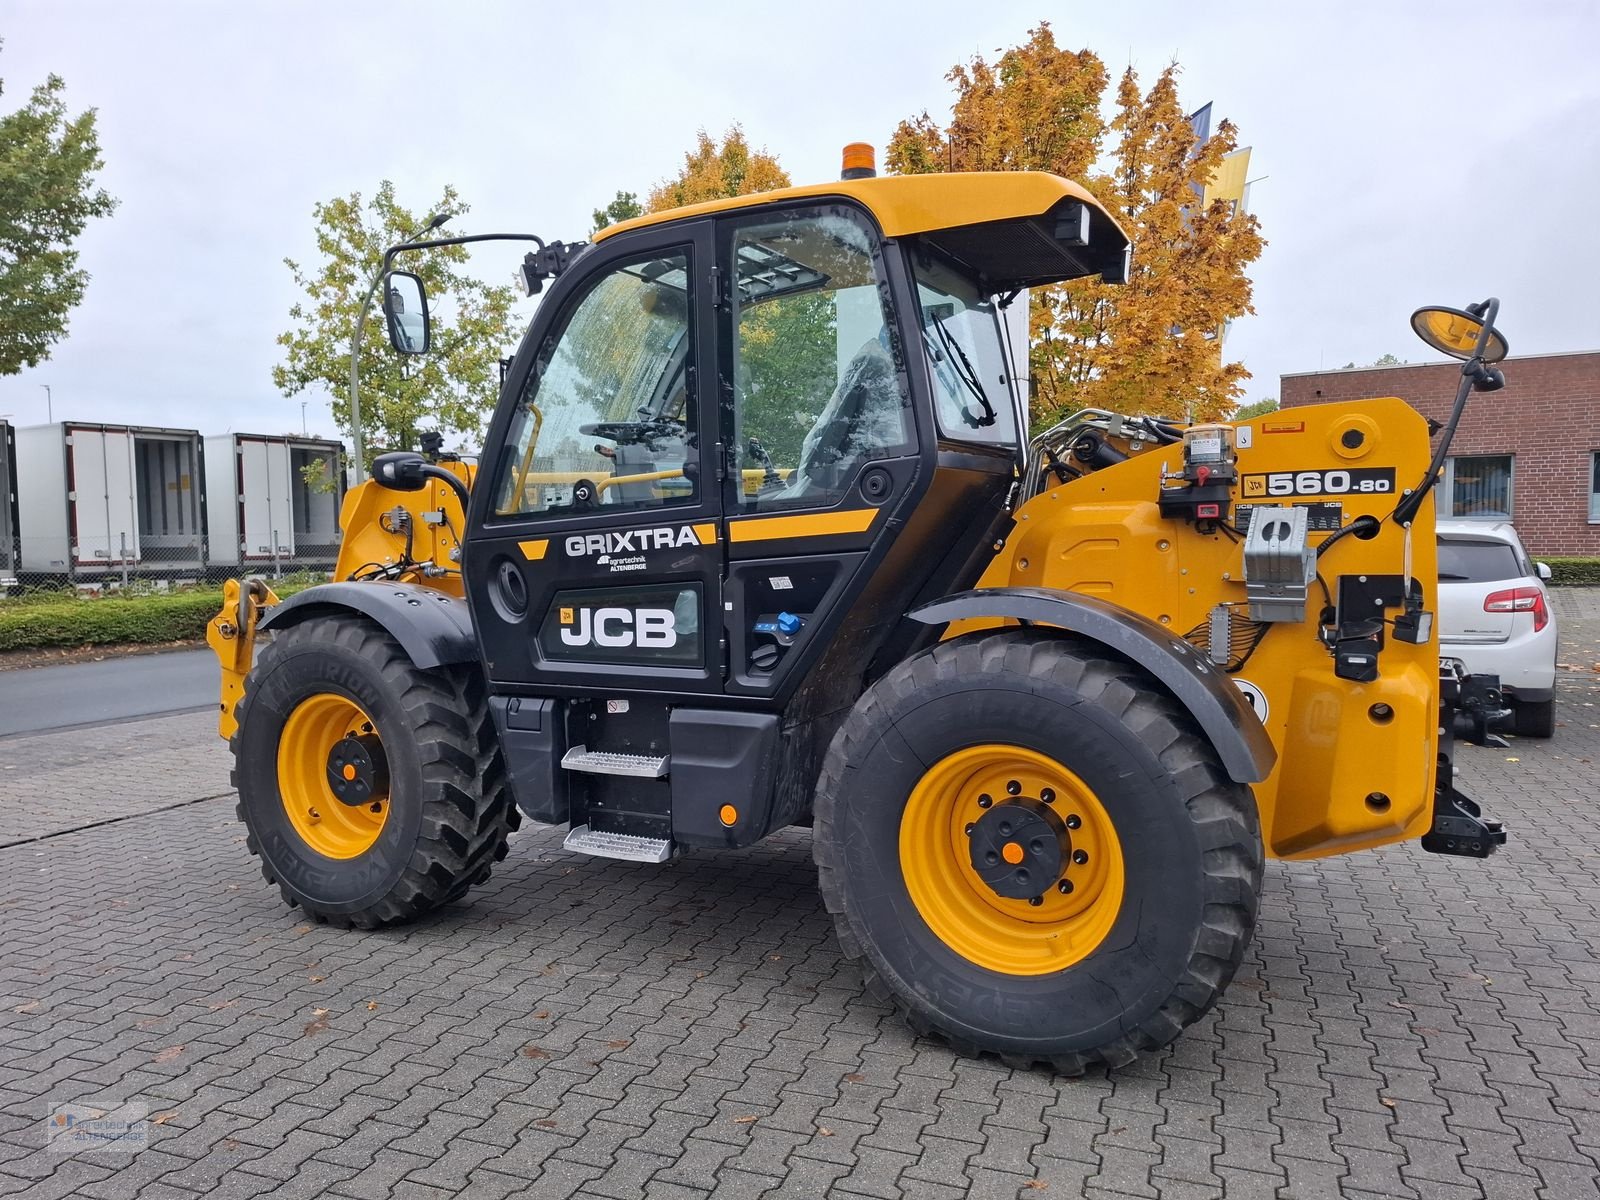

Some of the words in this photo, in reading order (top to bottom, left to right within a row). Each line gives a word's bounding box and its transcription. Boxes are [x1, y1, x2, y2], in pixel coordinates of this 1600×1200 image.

[565, 525, 699, 557] GRIXTRA
[609, 555, 646, 566] agrartechnik
[610, 563, 647, 573] ALTENBERGE
[560, 607, 677, 648] JCB
